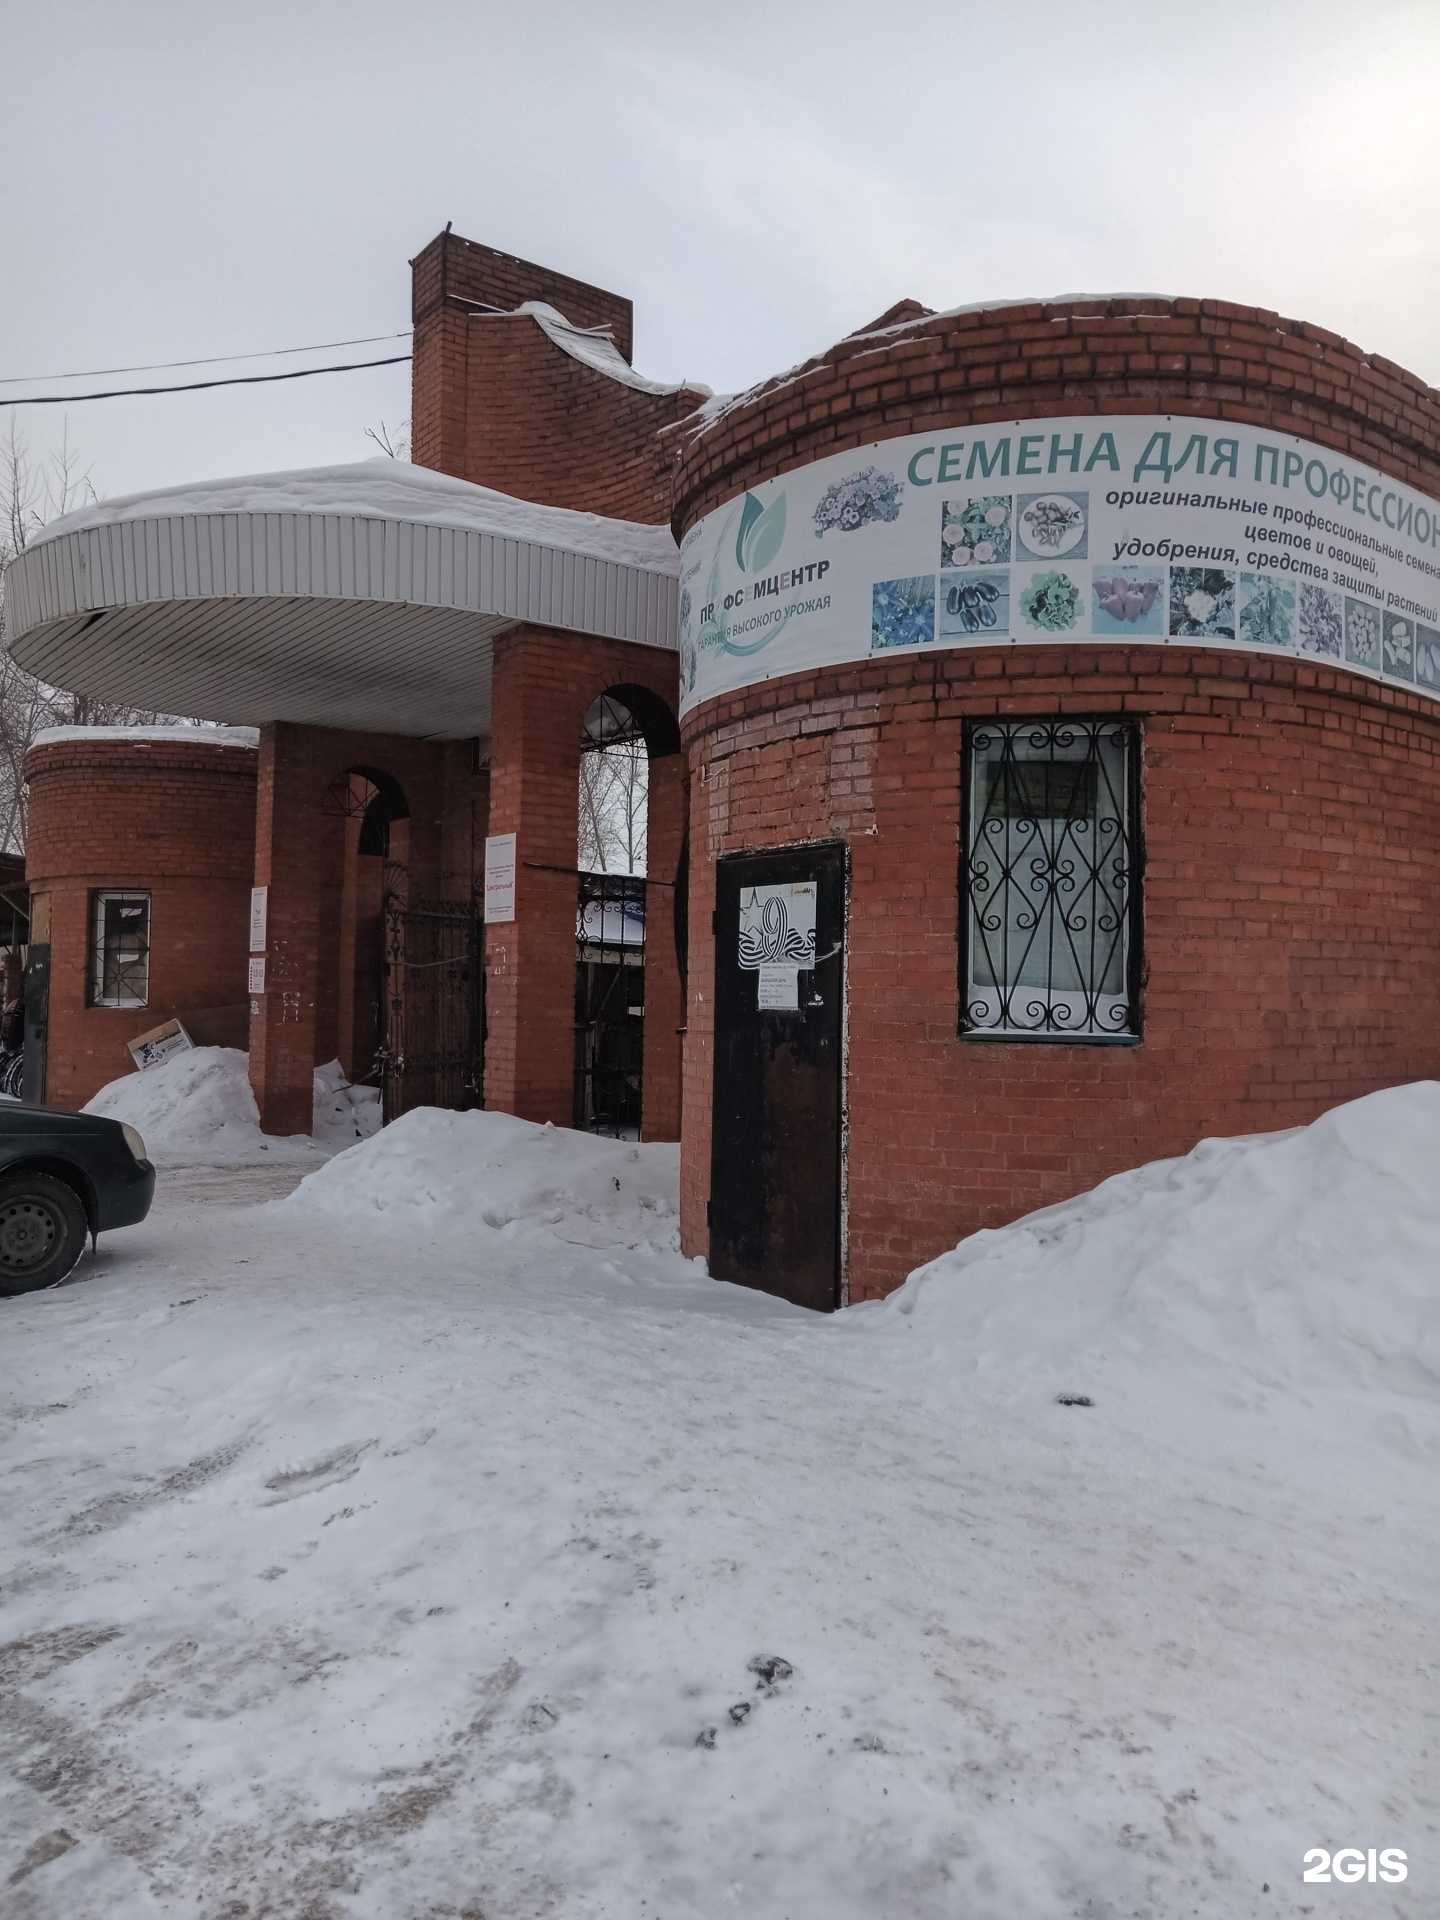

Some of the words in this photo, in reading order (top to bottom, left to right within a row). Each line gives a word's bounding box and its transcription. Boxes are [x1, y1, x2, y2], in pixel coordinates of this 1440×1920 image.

[907, 432, 1121, 486] СЕМЕНА
[1132, 432, 1240, 484] ДЛЯ
[1105, 490, 1268, 515] оригинальные
[1273, 504, 1403, 562] профессиональные
[1244, 524, 1312, 551] цветов
[1316, 541, 1324, 554] и
[1328, 546, 1379, 577] овощей,
[1112, 538, 1240, 565] удобрения,
[1246, 551, 1329, 581] средства
[1332, 571, 1385, 600] защиты
[1387, 592, 1438, 623] растений
[732, 608, 782, 637] ВЫСОКОГО
[783, 595, 832, 620] УРОЖАЯ
